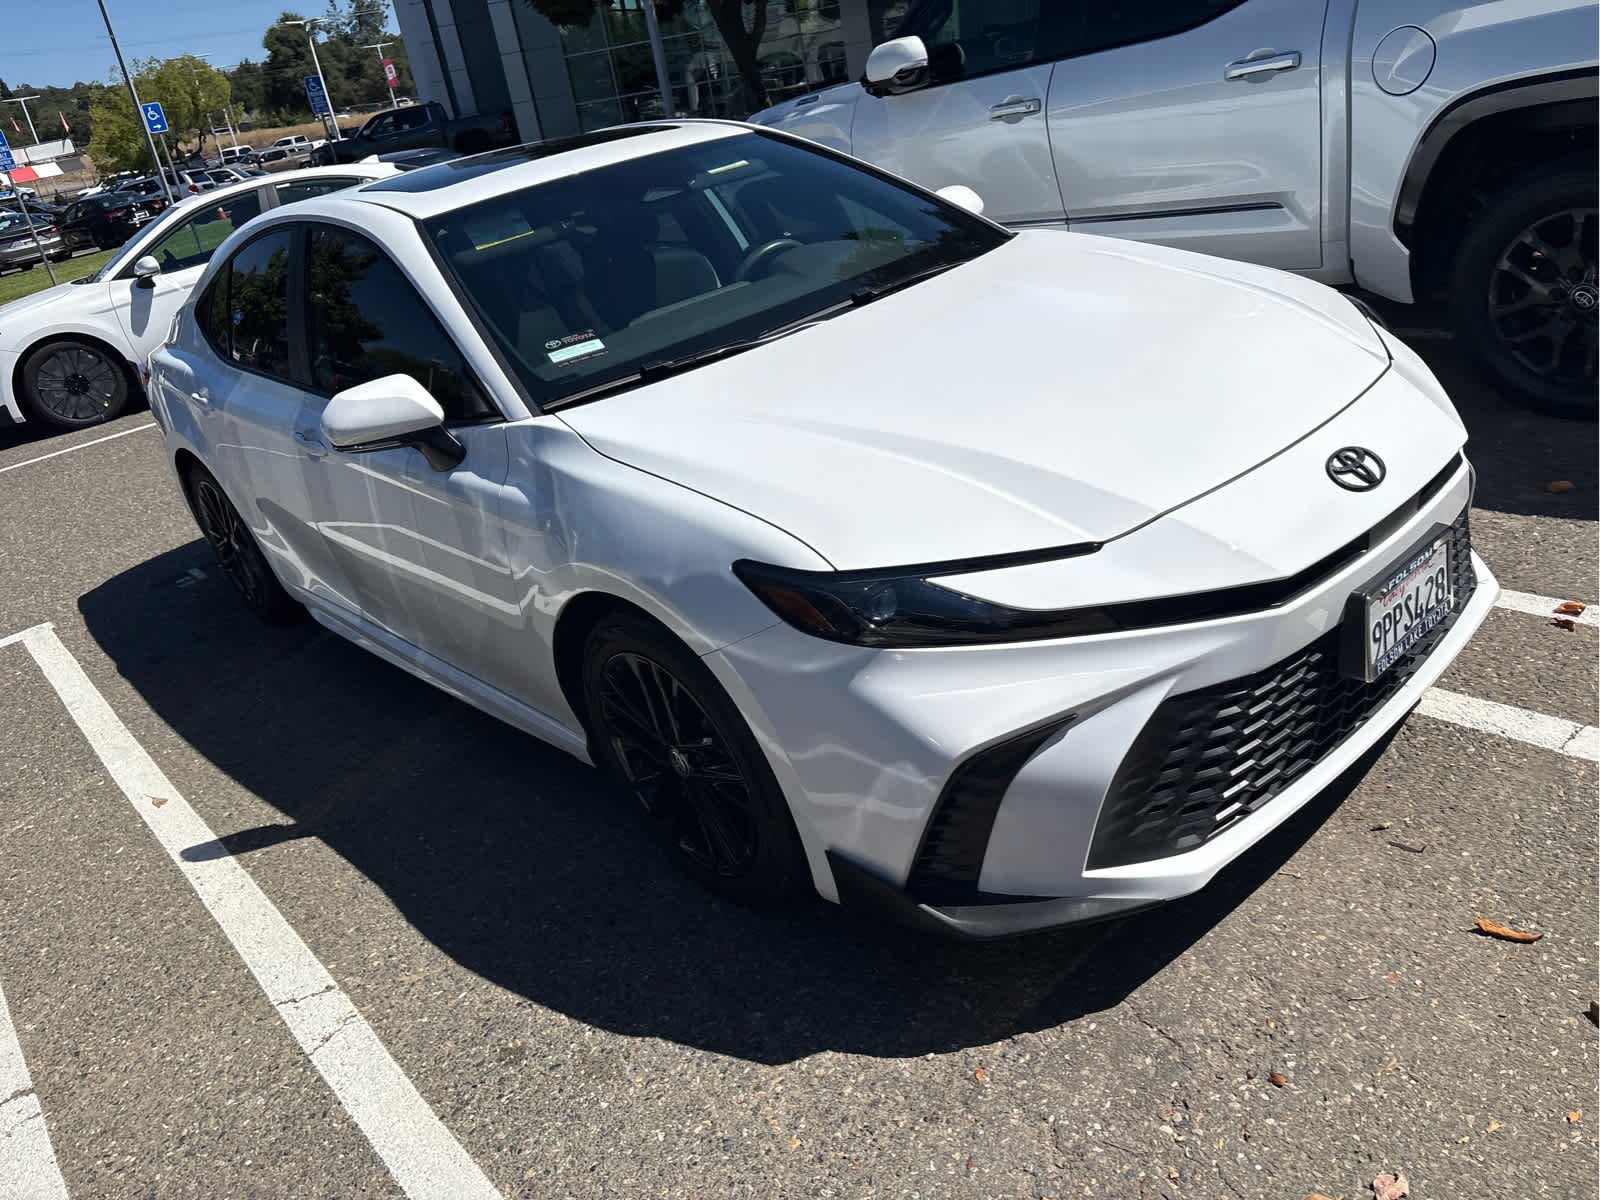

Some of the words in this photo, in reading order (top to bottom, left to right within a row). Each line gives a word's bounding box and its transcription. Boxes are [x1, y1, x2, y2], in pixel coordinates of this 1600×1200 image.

[1388, 547, 1433, 591] FOLSOM
[1372, 566, 1445, 666] 9PPS428
[1377, 639, 1405, 675] FOLSOM
[1405, 622, 1423, 649] LAKE
